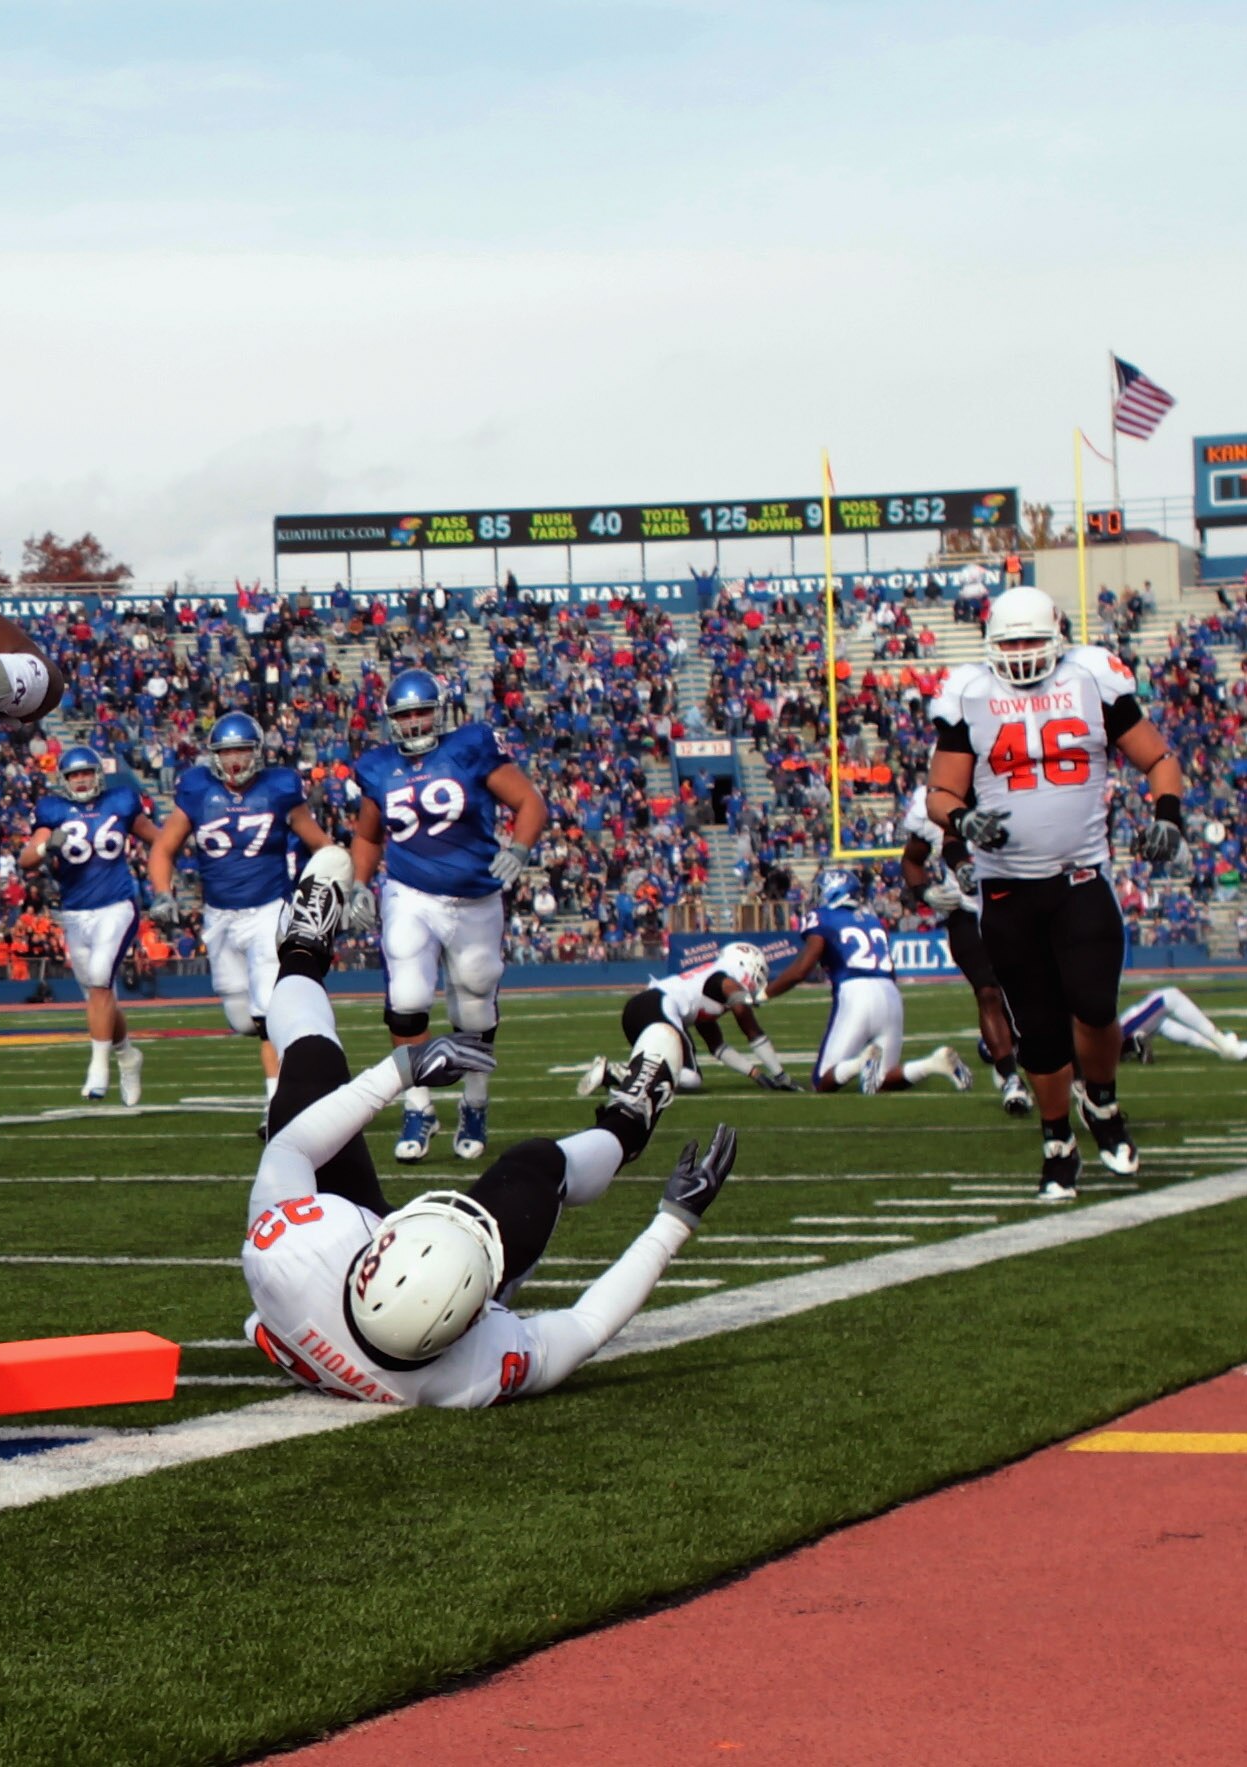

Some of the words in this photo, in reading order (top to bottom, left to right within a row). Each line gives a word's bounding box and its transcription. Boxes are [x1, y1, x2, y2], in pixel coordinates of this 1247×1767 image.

[641, 508, 689, 523] TOTAL
[761, 503, 789, 518] 1ST
[805, 503, 823, 527] 9
[839, 500, 882, 516] POSS.
[887, 498, 946, 524] 5:52
[431, 516, 468, 530] PASS
[479, 515, 512, 540] 85
[532, 512, 573, 527] RUSH
[589, 511, 622, 536] 40
[641, 521, 691, 537] YARDS
[700, 506, 747, 532] 125
[747, 516, 803, 532] DOWNS
[842, 514, 880, 529] TIME
[1088, 510, 1122, 535] 40
[277, 527, 386, 541] KUATHLETICS.COM
[426, 529, 474, 544] YARDS
[528, 526, 578, 541] YARDS
[853, 571, 1001, 592] MCLINTN
[518, 588, 570, 604] OHN
[655, 584, 683, 599] 21
[989, 692, 1073, 716] COWBOYS
[988, 717, 1091, 792] 46
[386, 778, 466, 843] 59
[196, 813, 274, 859] 67
